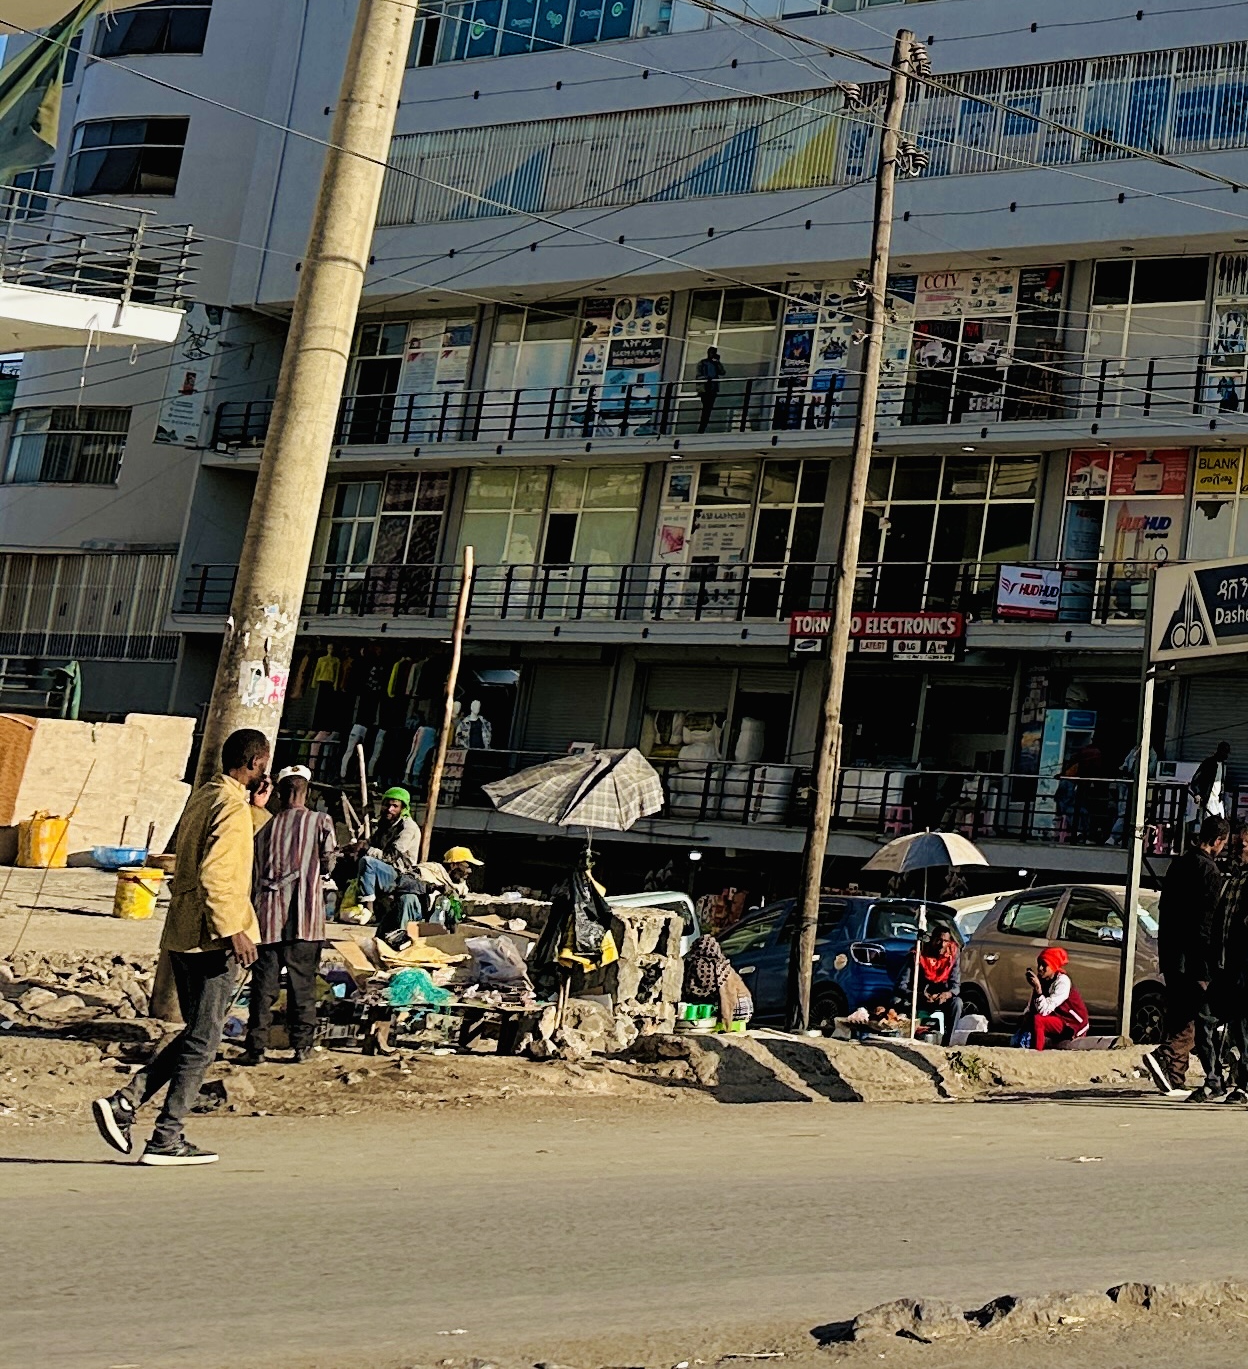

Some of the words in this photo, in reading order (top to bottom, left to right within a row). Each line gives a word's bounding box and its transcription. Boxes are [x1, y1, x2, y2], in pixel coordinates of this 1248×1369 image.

[924, 272, 960, 290] CCTV
[1199, 456, 1239, 471] BLANK
[1019, 583, 1060, 598] HUDHUD
[794, 615, 862, 633] TORNO
[865, 616, 957, 636] ELECTRONICS
